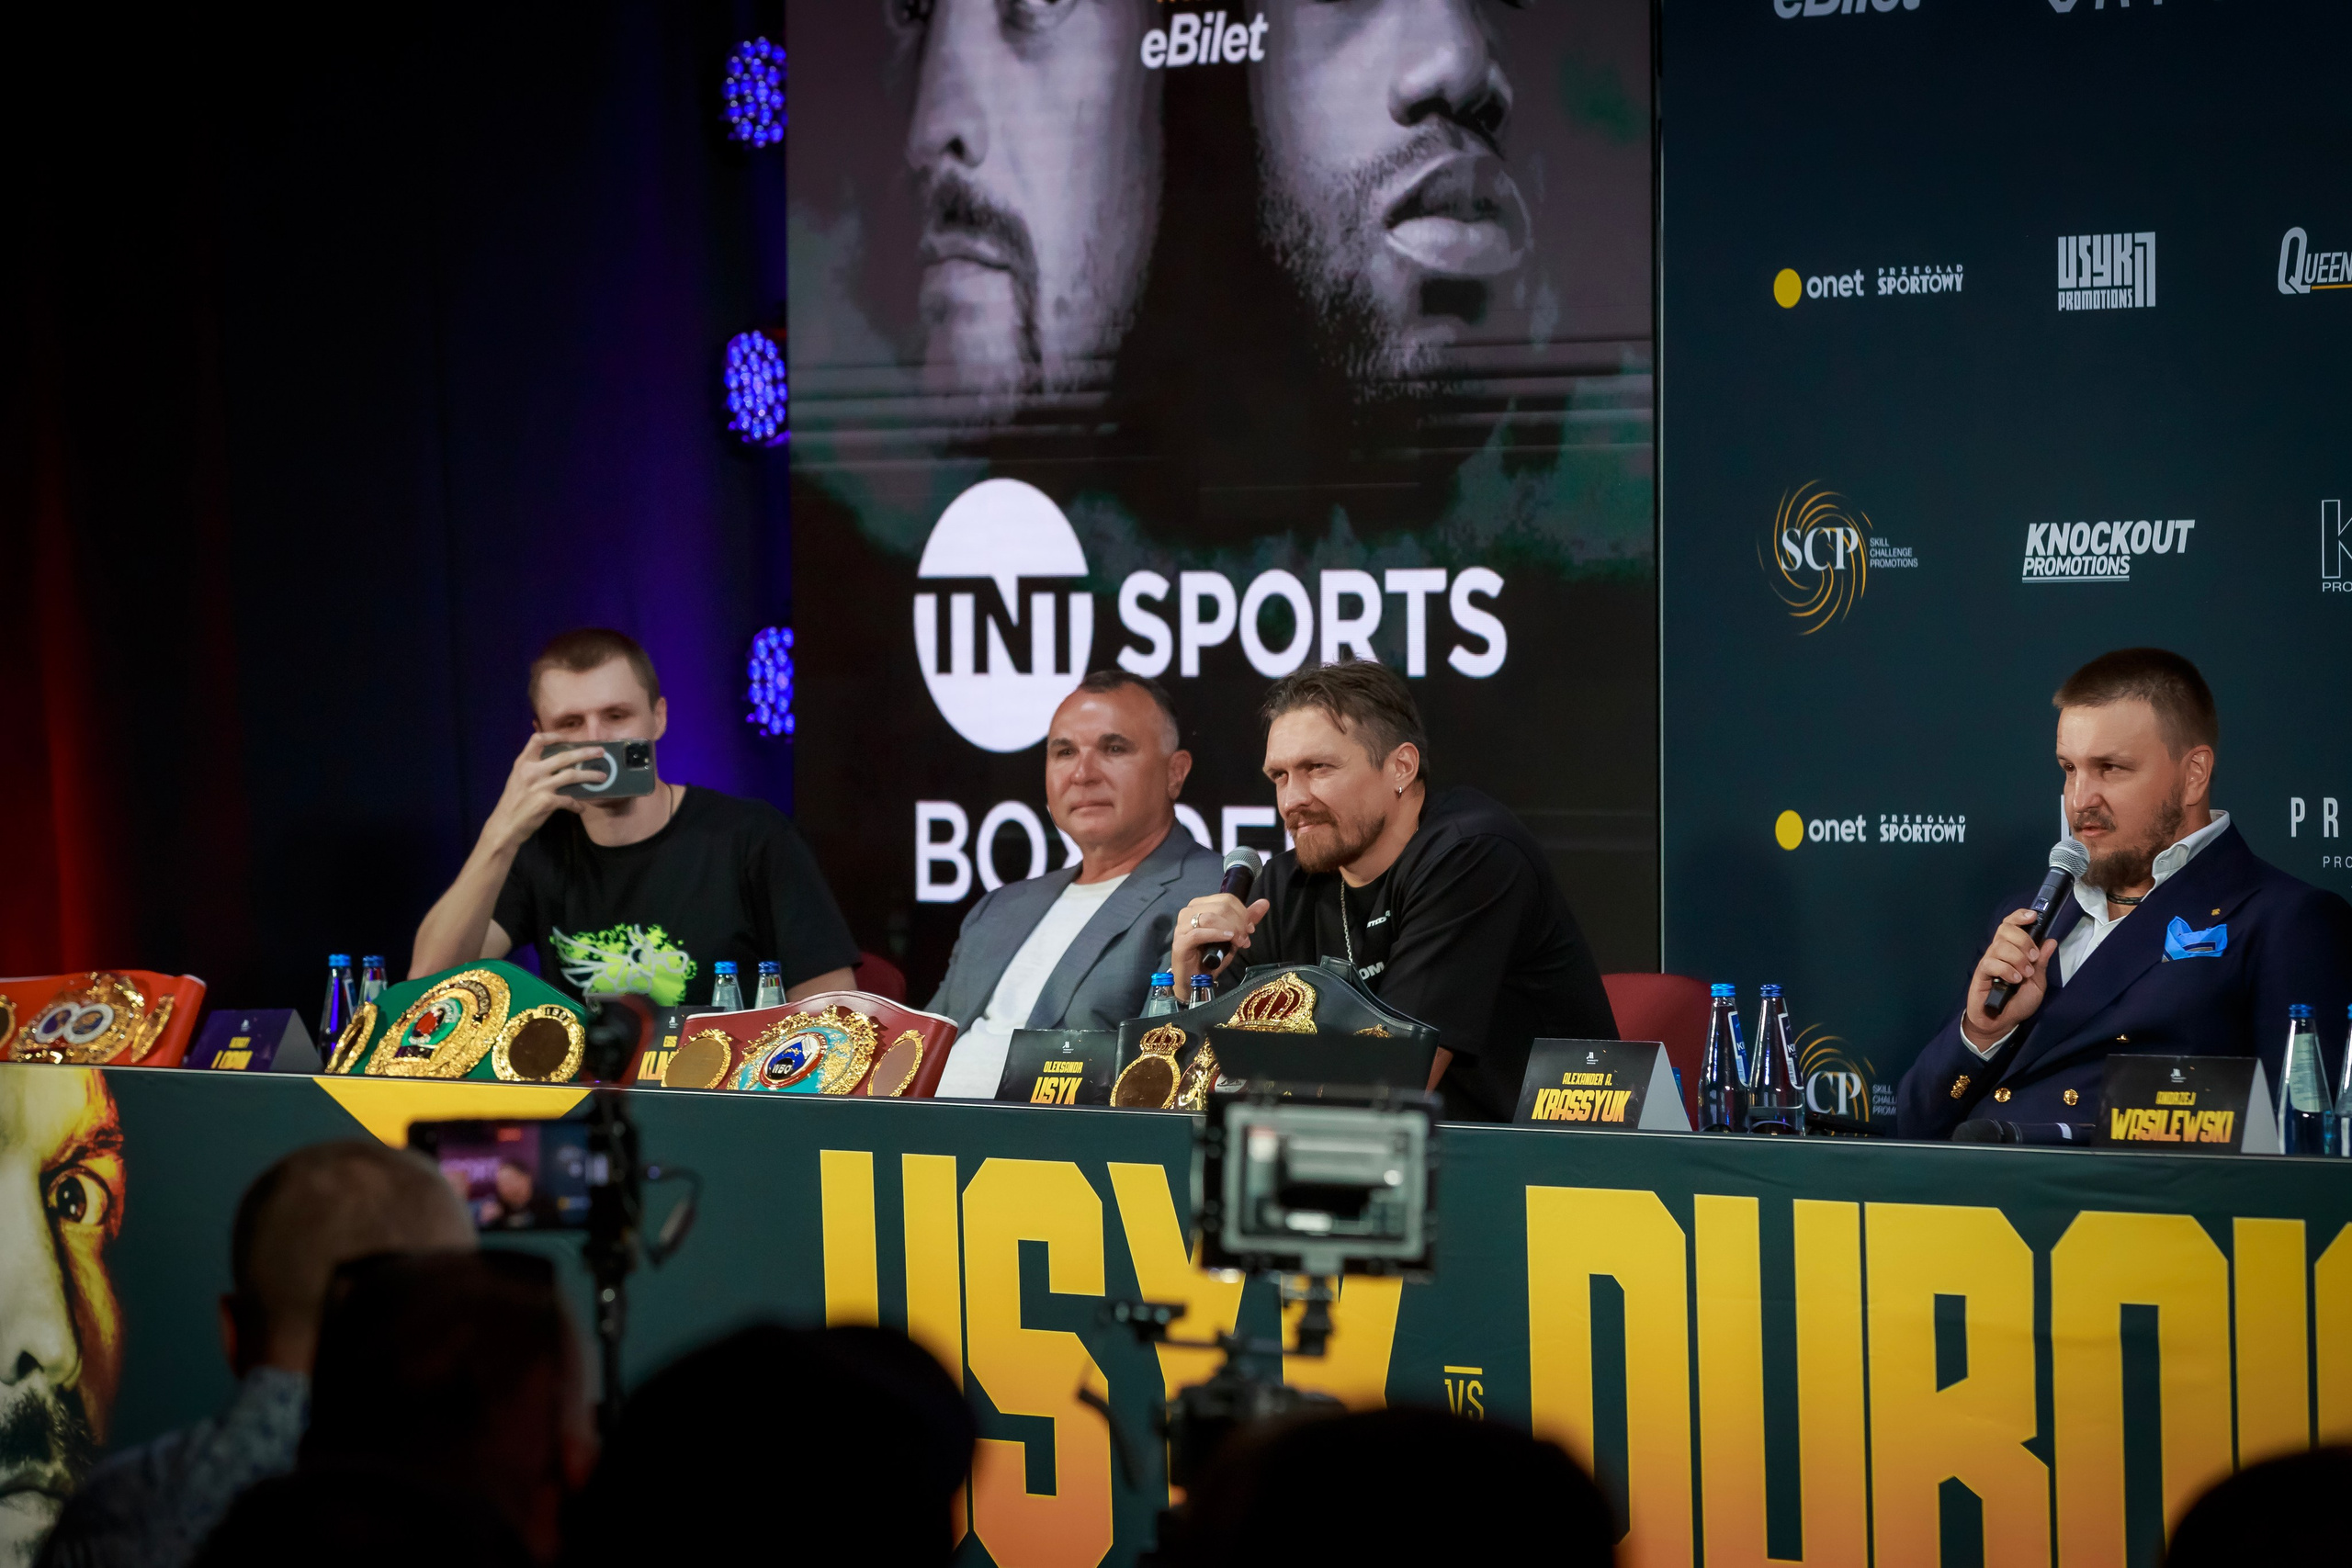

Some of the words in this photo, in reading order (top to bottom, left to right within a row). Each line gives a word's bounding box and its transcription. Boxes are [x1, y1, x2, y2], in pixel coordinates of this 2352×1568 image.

[1141, 11, 1269, 69] eBilet
[1806, 269, 1865, 299] onet
[1877, 273, 1963, 296] SPORTOWY
[2058, 288, 2132, 311] PROMOTIONS
[1781, 526, 1860, 571] SCP
[1869, 537, 1890, 547] SKILL
[2025, 519, 2196, 557] KNOCKOUT
[1869, 547, 1913, 558] CHALLENGE
[1869, 558, 1918, 569] PROMOTIONS
[2023, 555, 2132, 577] PROMOTIONS
[1116, 566, 1508, 679] SPORTS
[1808, 814, 1867, 842] onet
[1880, 823, 1966, 843] SPORTOWY
[772, 1063, 793, 1075] WBO
[1043, 1061, 1083, 1074] OLEKSANDR
[1562, 1072, 1604, 1086] ALEXANDER
[1030, 1077, 1083, 1105] USYK
[1531, 1088, 1632, 1122] KRASSYUK
[1806, 1070, 1862, 1115] CP
[2110, 1108, 2235, 1144] WASILEWSKI
[1526, 1185, 2352, 1568] DUBOI
[1443, 1379, 1485, 1422] VS
